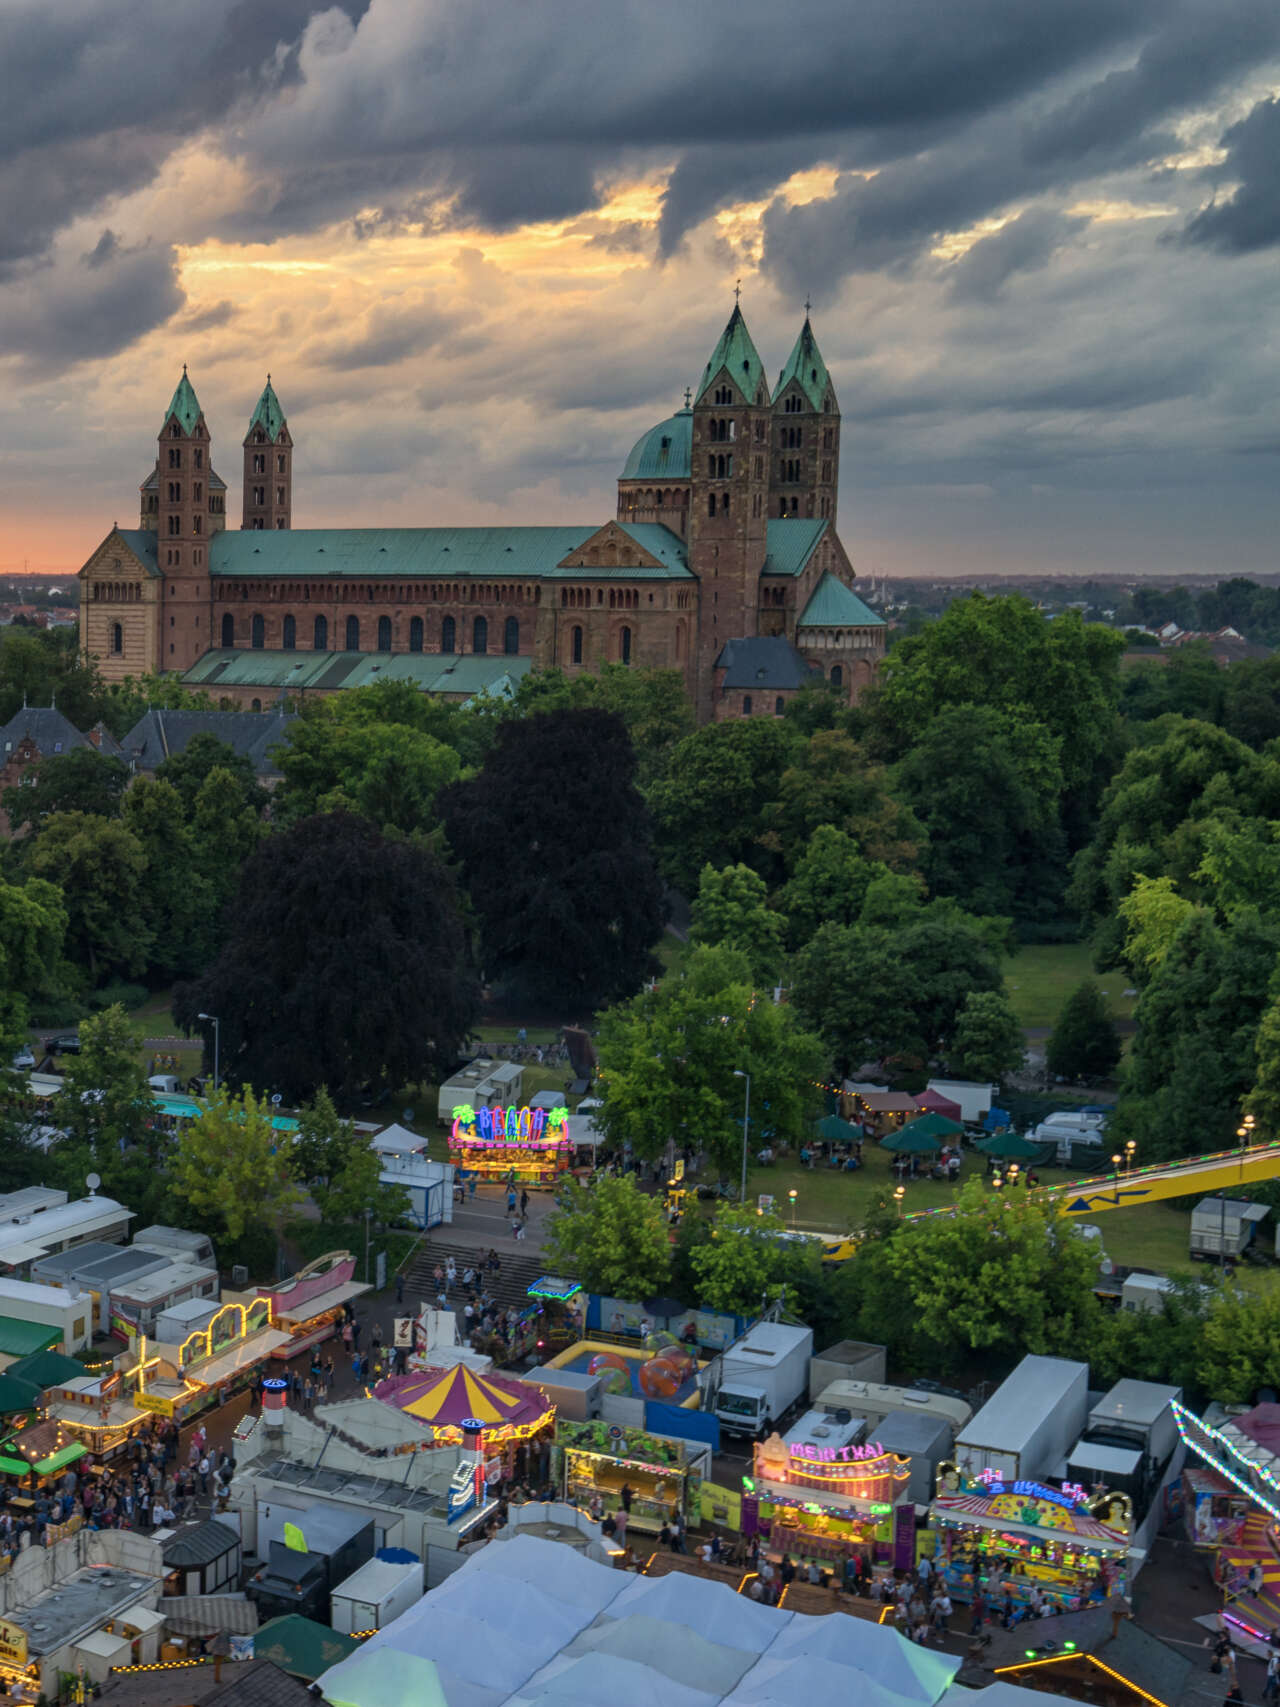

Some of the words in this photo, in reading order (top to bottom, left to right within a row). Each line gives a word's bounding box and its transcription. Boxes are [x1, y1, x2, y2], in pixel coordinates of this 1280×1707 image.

[480, 1107, 544, 1130] BEACH
[790, 1442, 837, 1462] MEIN
[838, 1441, 886, 1462] THAI
